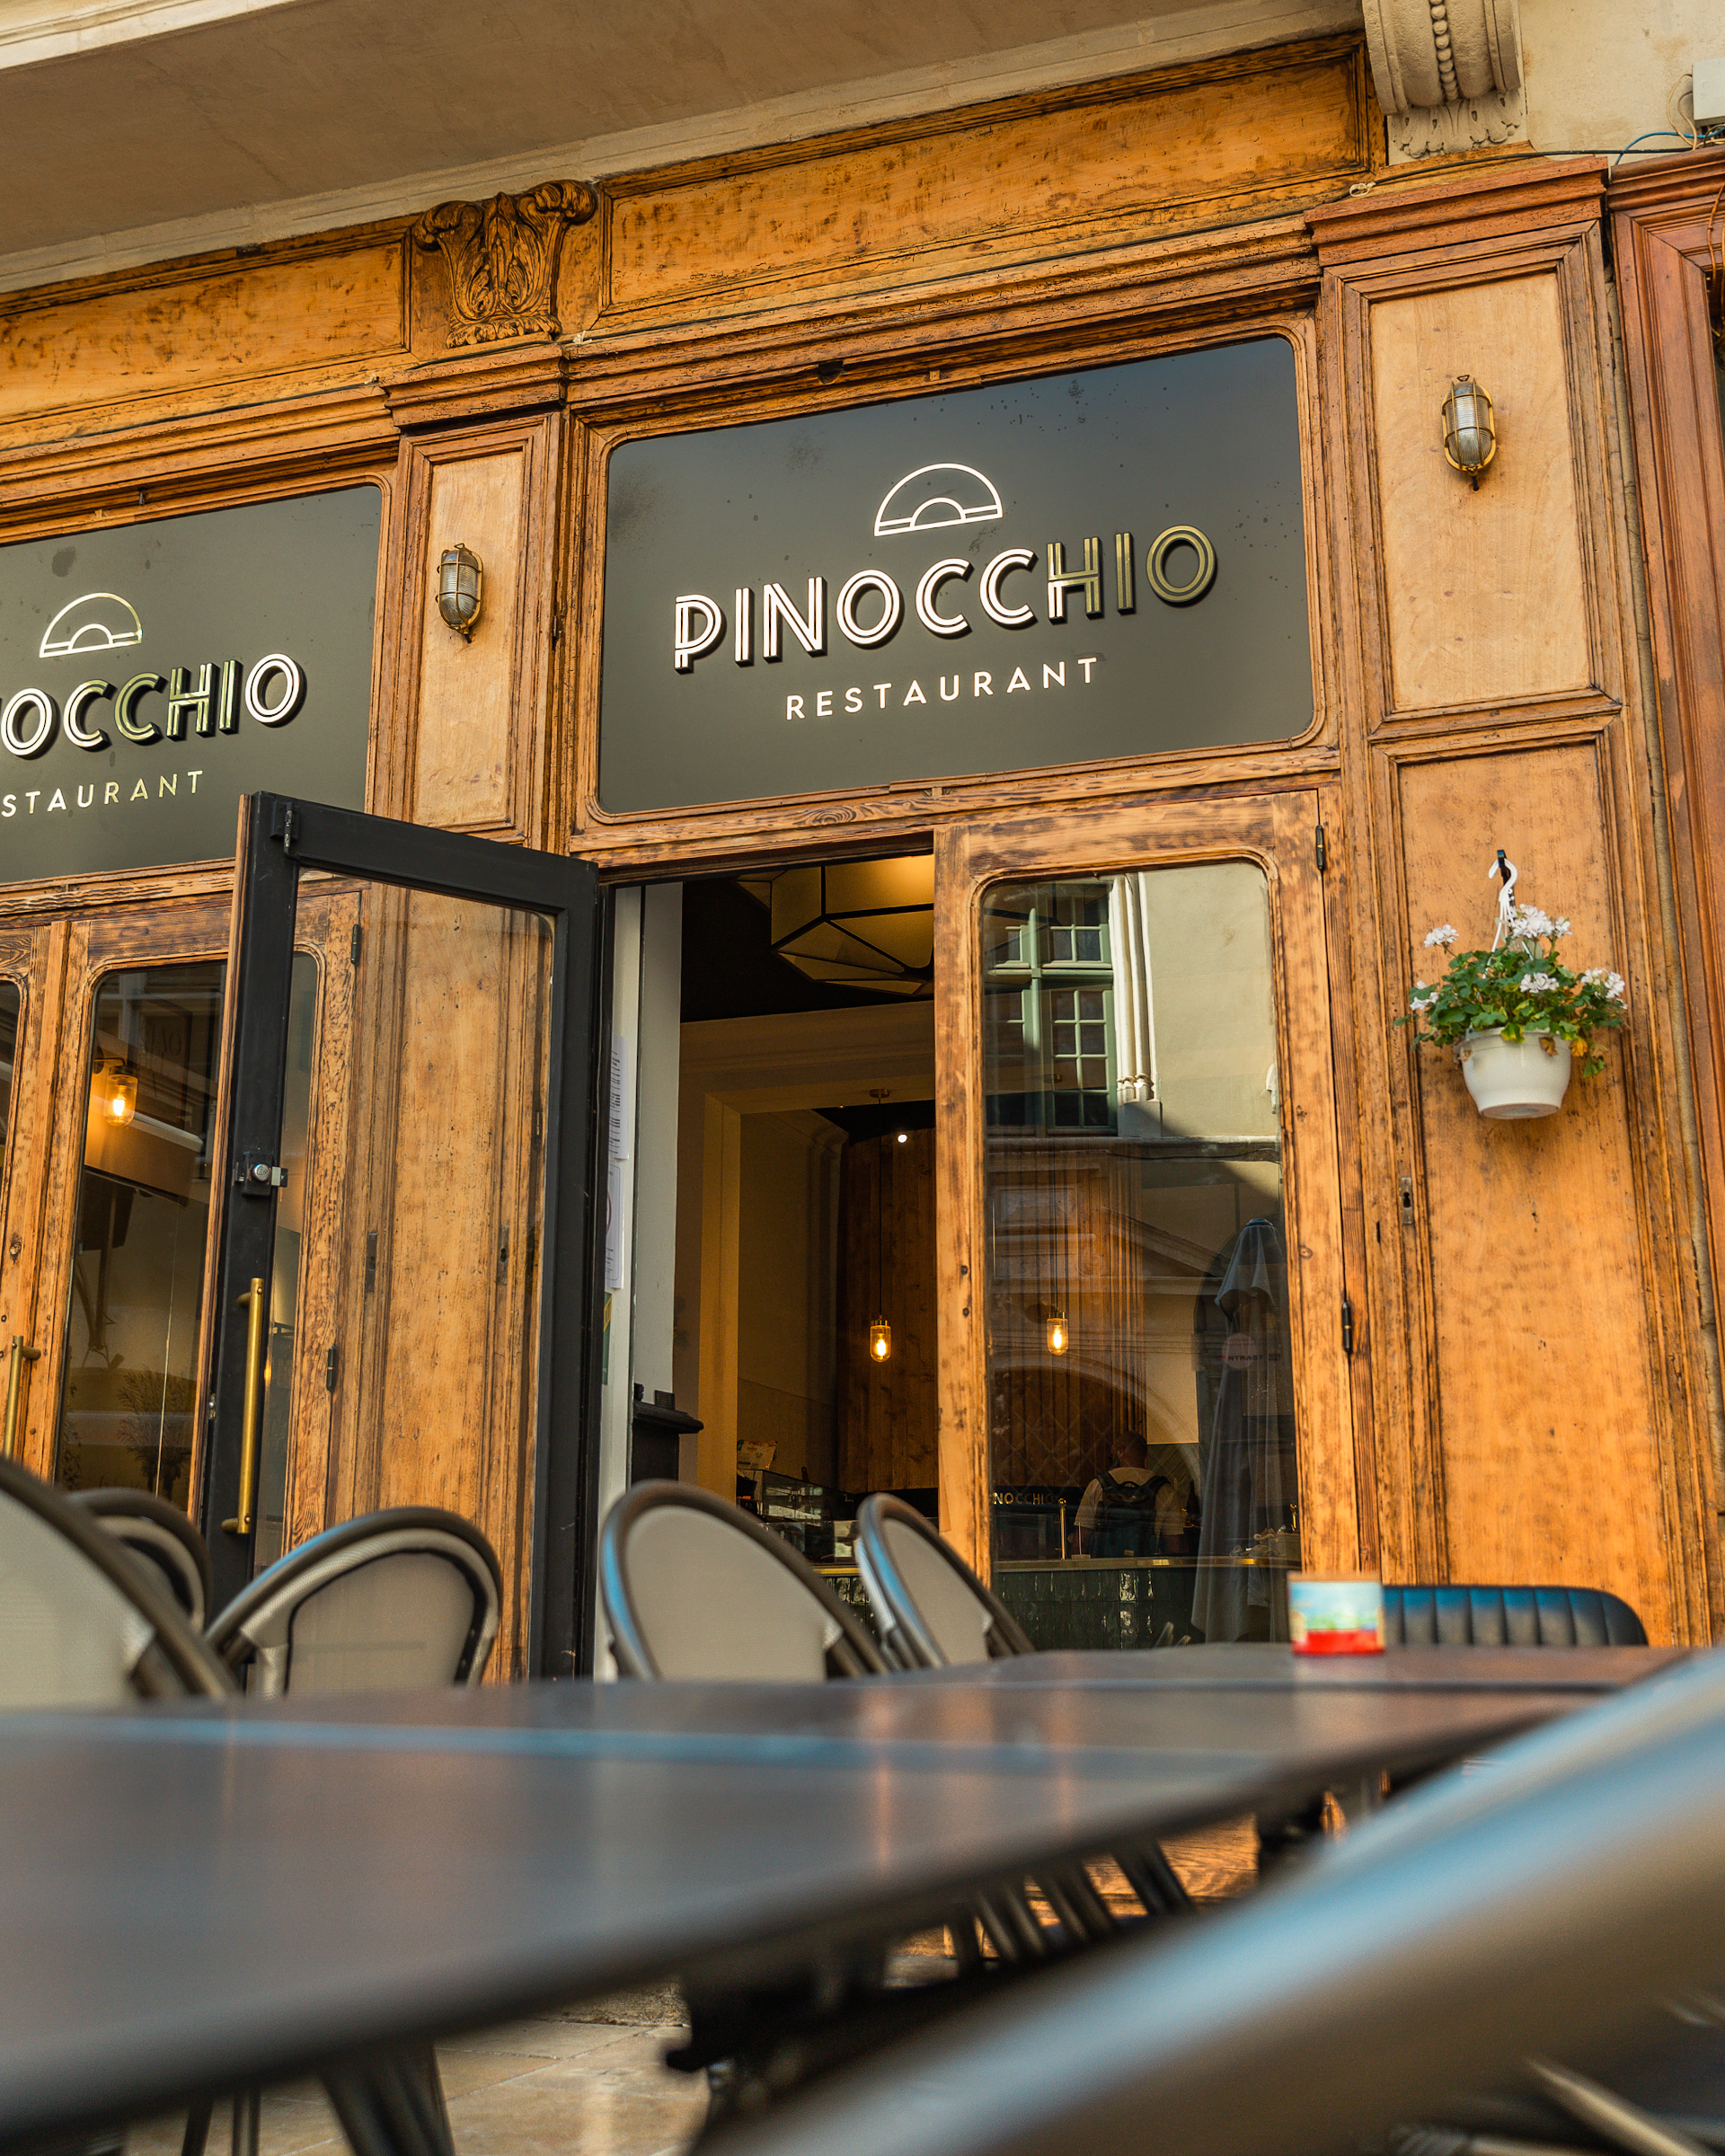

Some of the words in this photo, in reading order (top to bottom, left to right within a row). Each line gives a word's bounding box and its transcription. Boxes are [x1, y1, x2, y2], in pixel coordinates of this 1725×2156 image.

[674, 525, 1216, 673] PINOCCHIO
[0, 653, 305, 759] OCCHIO
[786, 657, 1098, 720] RESTAURANT
[1, 770, 203, 817] STAURANT
